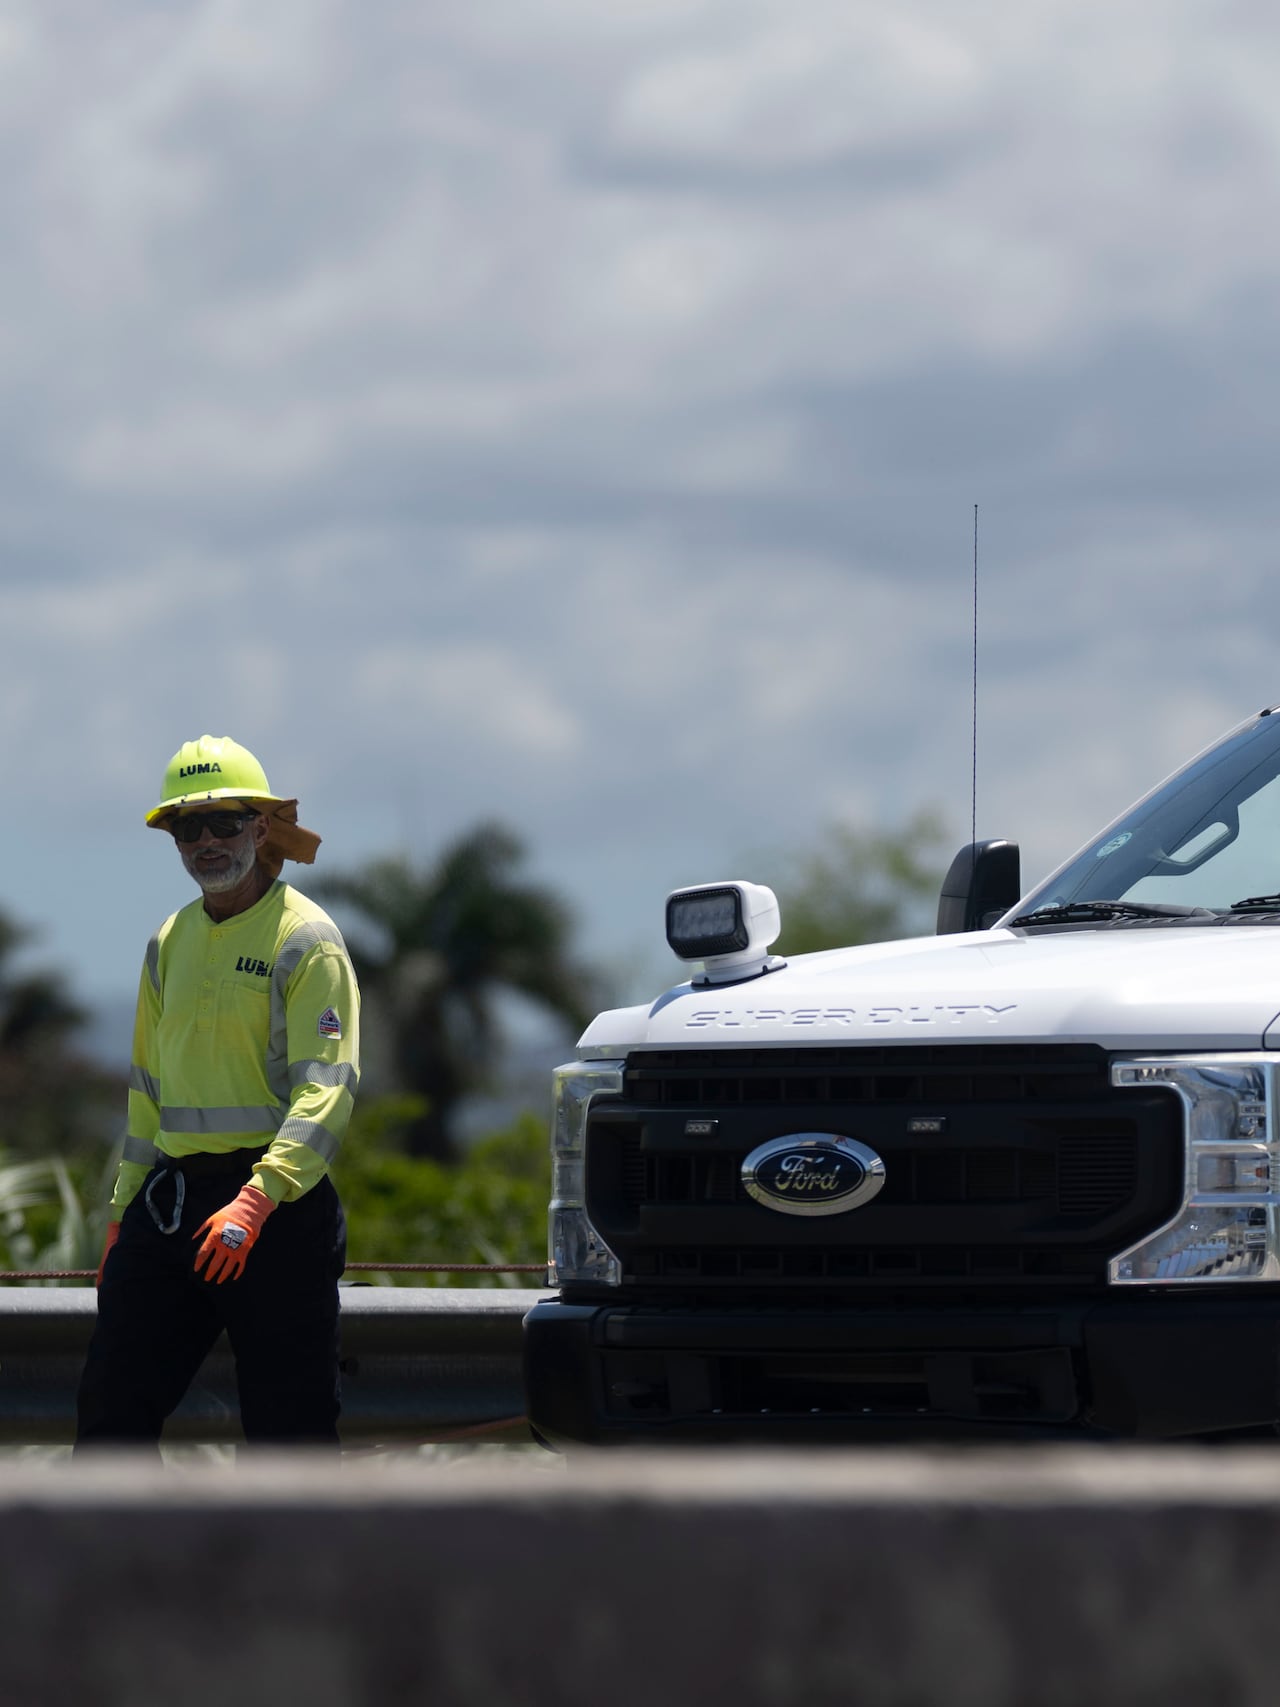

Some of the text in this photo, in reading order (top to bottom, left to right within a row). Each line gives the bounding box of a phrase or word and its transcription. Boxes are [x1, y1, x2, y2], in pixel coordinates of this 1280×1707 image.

[180, 762, 222, 778] LUMA
[683, 1004, 1018, 1029] SUPER DUTY
[774, 1155, 841, 1190] Ford
